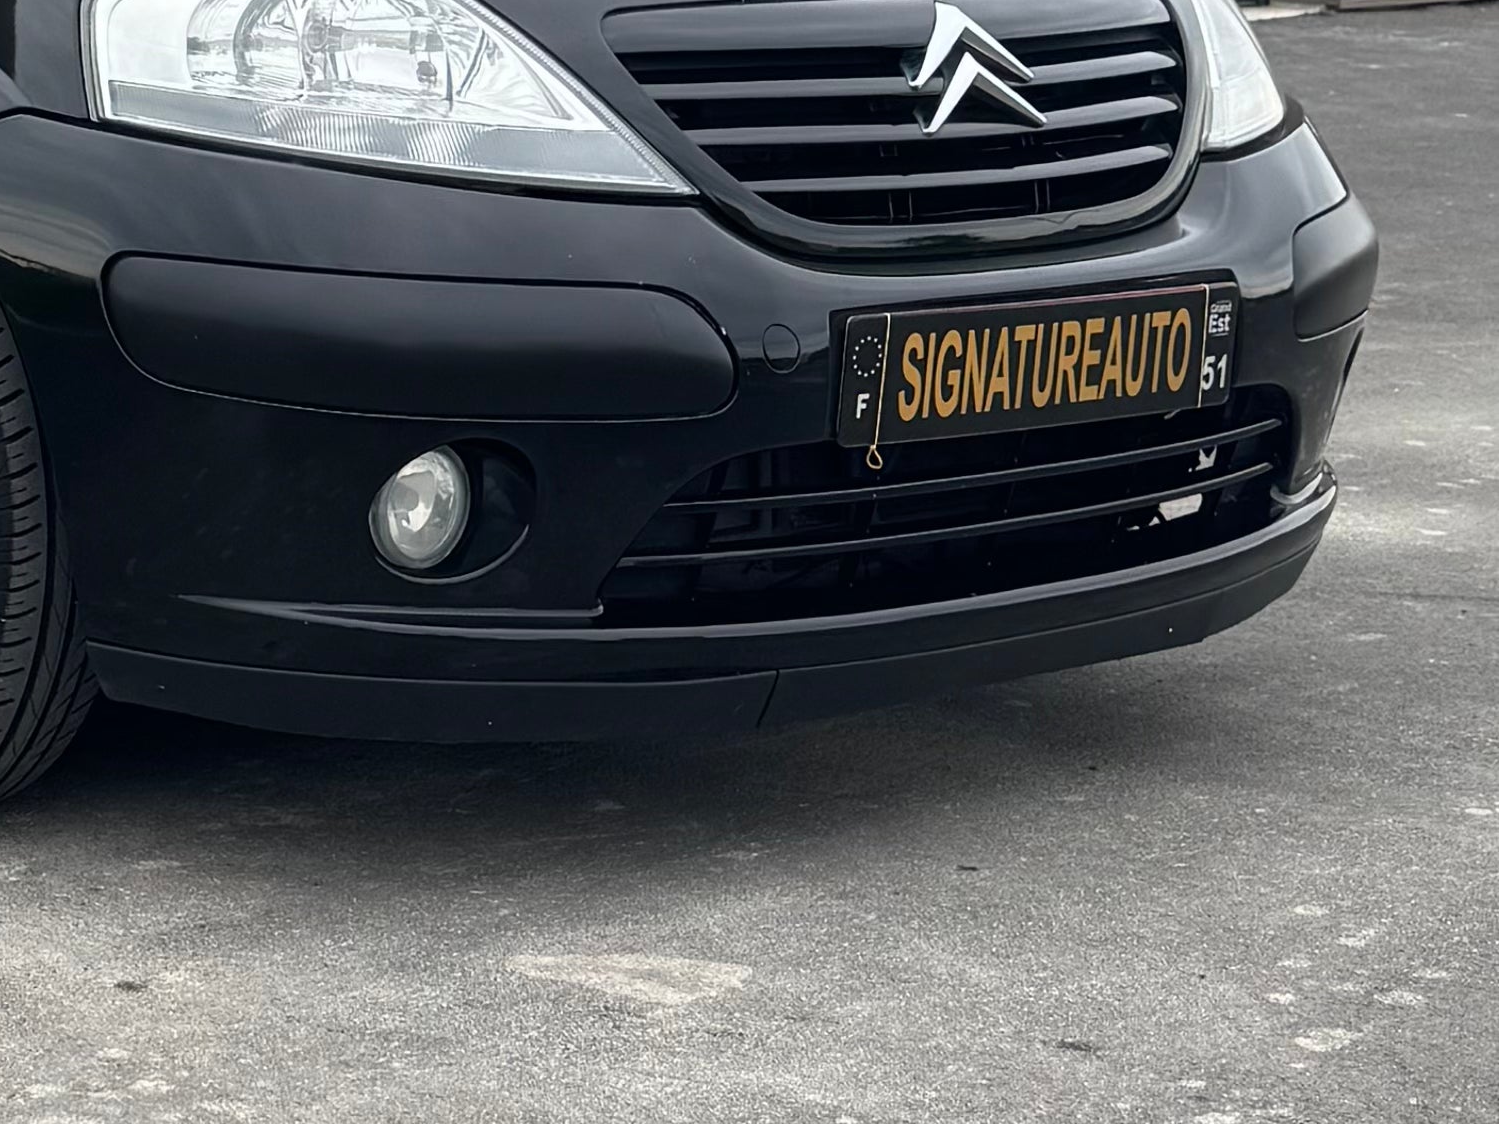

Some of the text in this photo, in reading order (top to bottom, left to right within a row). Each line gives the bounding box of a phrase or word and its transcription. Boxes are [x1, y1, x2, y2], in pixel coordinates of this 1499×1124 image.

[1208, 314, 1231, 333] Est
[898, 308, 1191, 421] SIGNATUREAUTO
[1202, 354, 1227, 390] 51
[856, 393, 870, 419] F
